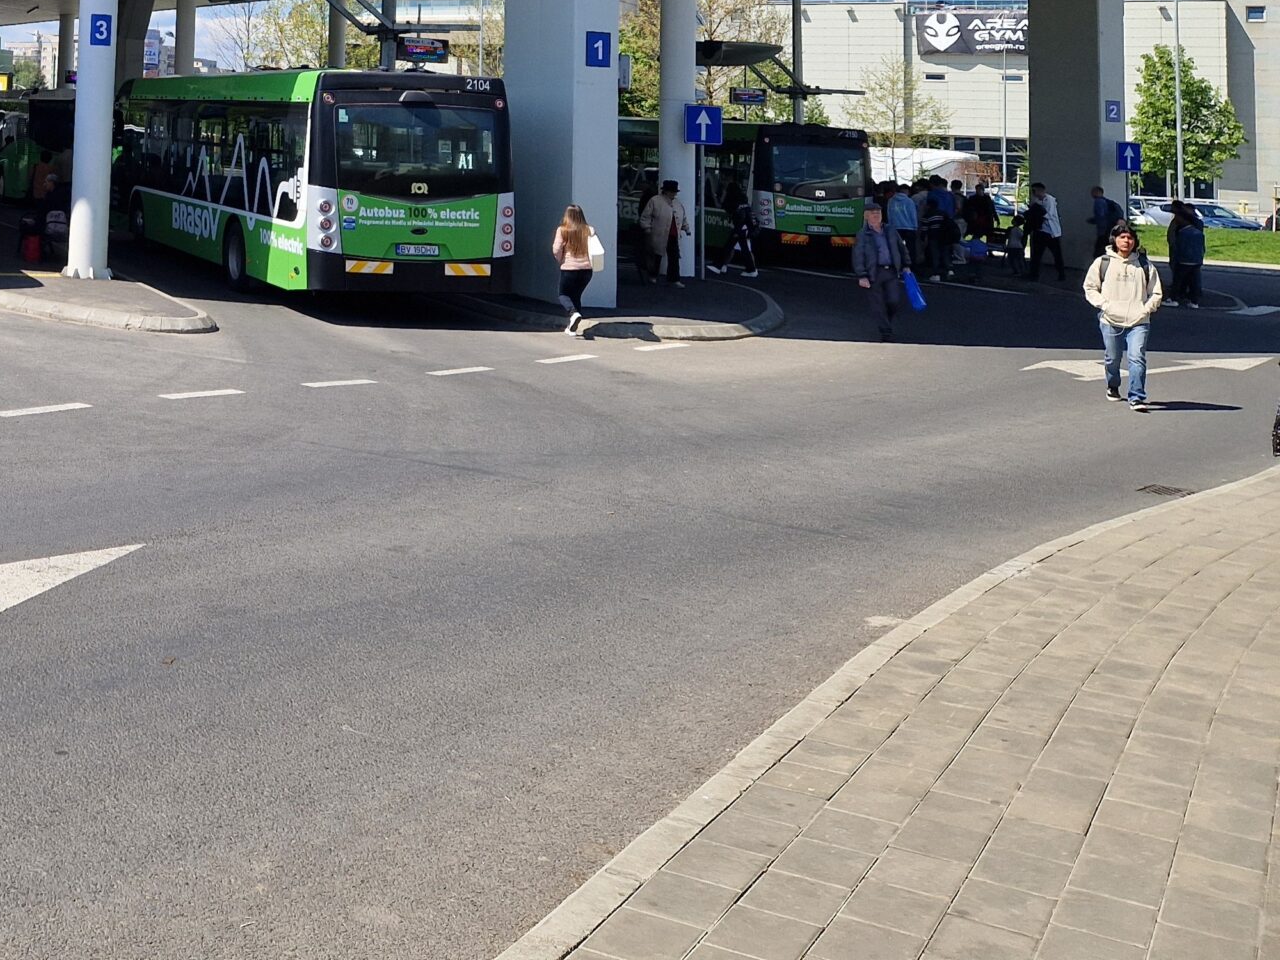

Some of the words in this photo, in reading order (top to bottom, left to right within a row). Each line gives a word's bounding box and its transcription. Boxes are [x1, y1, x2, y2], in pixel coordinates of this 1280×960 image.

[95, 20, 108, 40] 3
[967, 18, 1028, 30] AREA
[973, 29, 1025, 42] GYM
[593, 39, 603, 60] 1
[975, 43, 1025, 51] areagym.ro
[466, 78, 490, 91] 2104
[1109, 105, 1118, 118] 2
[458, 153, 473, 170] A1
[346, 197, 354, 206] 70
[359, 206, 406, 219] Autobuz
[408, 207, 438, 219] 100%
[440, 208, 480, 220] electric
[277, 233, 304, 256] electric
